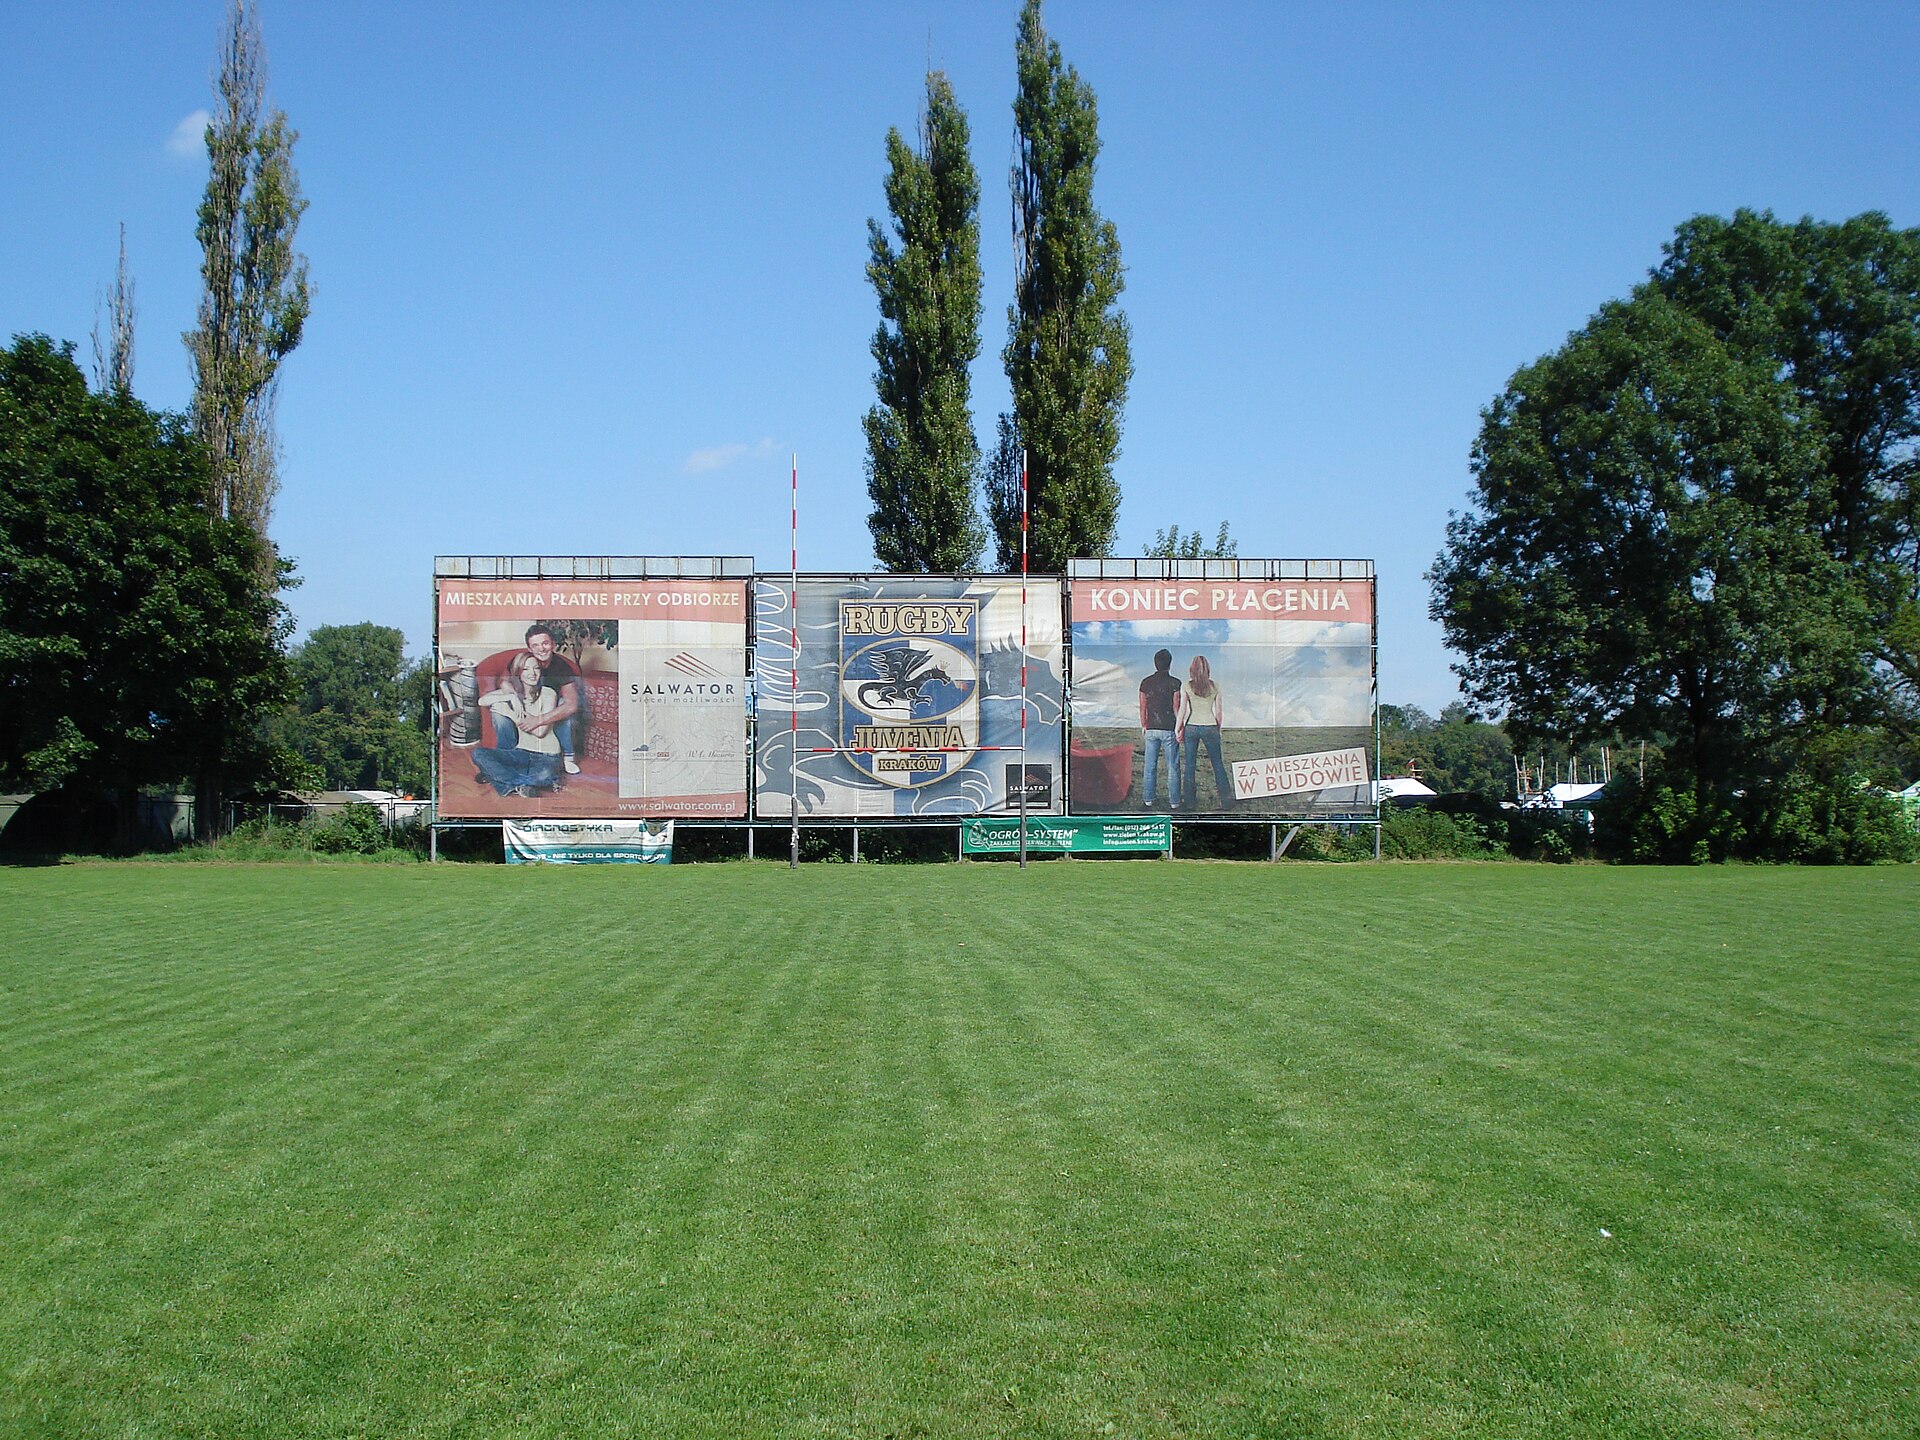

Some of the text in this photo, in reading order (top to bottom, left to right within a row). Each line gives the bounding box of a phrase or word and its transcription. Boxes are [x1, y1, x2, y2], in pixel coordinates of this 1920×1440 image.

[445, 592, 739, 606] MIESZKANIA PŁATNE PRZY ODBIORZE
[1091, 588, 1350, 611] KONIEC PŁACENIA
[844, 605, 973, 635] RUGBY
[631, 684, 734, 695] SALWATOR
[851, 726, 966, 752] JUVENIA
[879, 755, 940, 770] KRAKÓW
[1238, 753, 1360, 777] ZA MIESZKANIA
[1238, 766, 1362, 794] W BUDOWIE
[618, 800, 736, 812] www.salwator.com.pl
